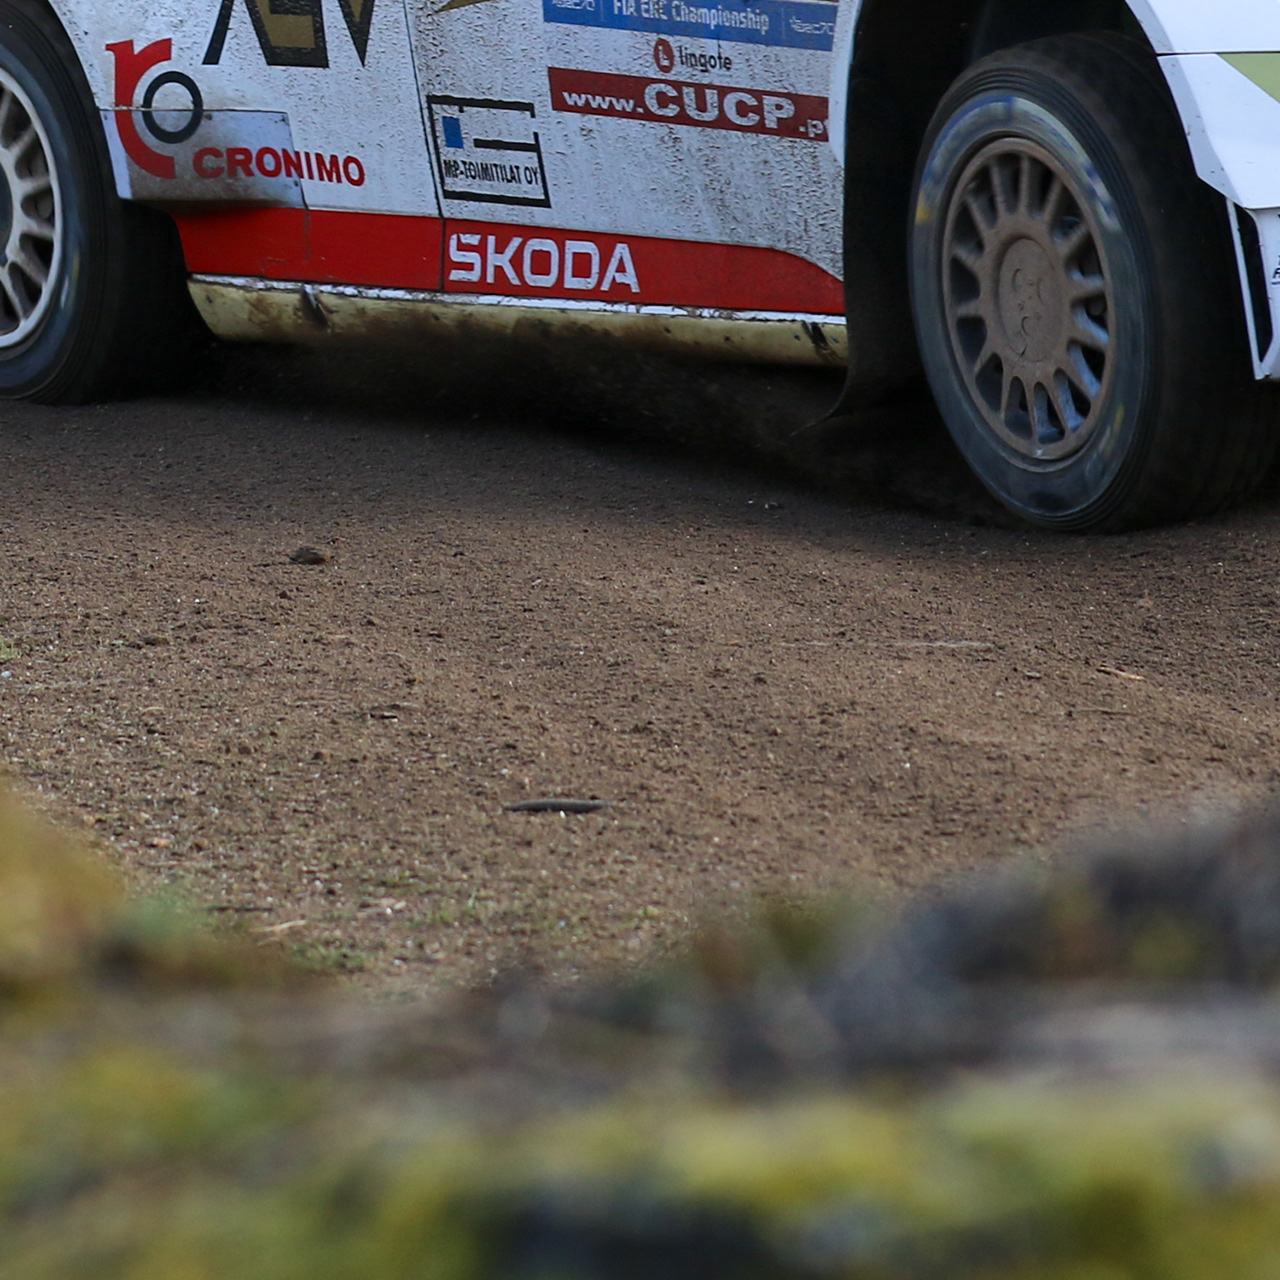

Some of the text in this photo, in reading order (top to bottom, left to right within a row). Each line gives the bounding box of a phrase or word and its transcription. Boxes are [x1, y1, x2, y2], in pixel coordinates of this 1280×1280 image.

[670, 0, 769, 35] Championship
[679, 44, 732, 72] lingote
[192, 146, 366, 188] CRONIMO
[523, 165, 539, 186] OY
